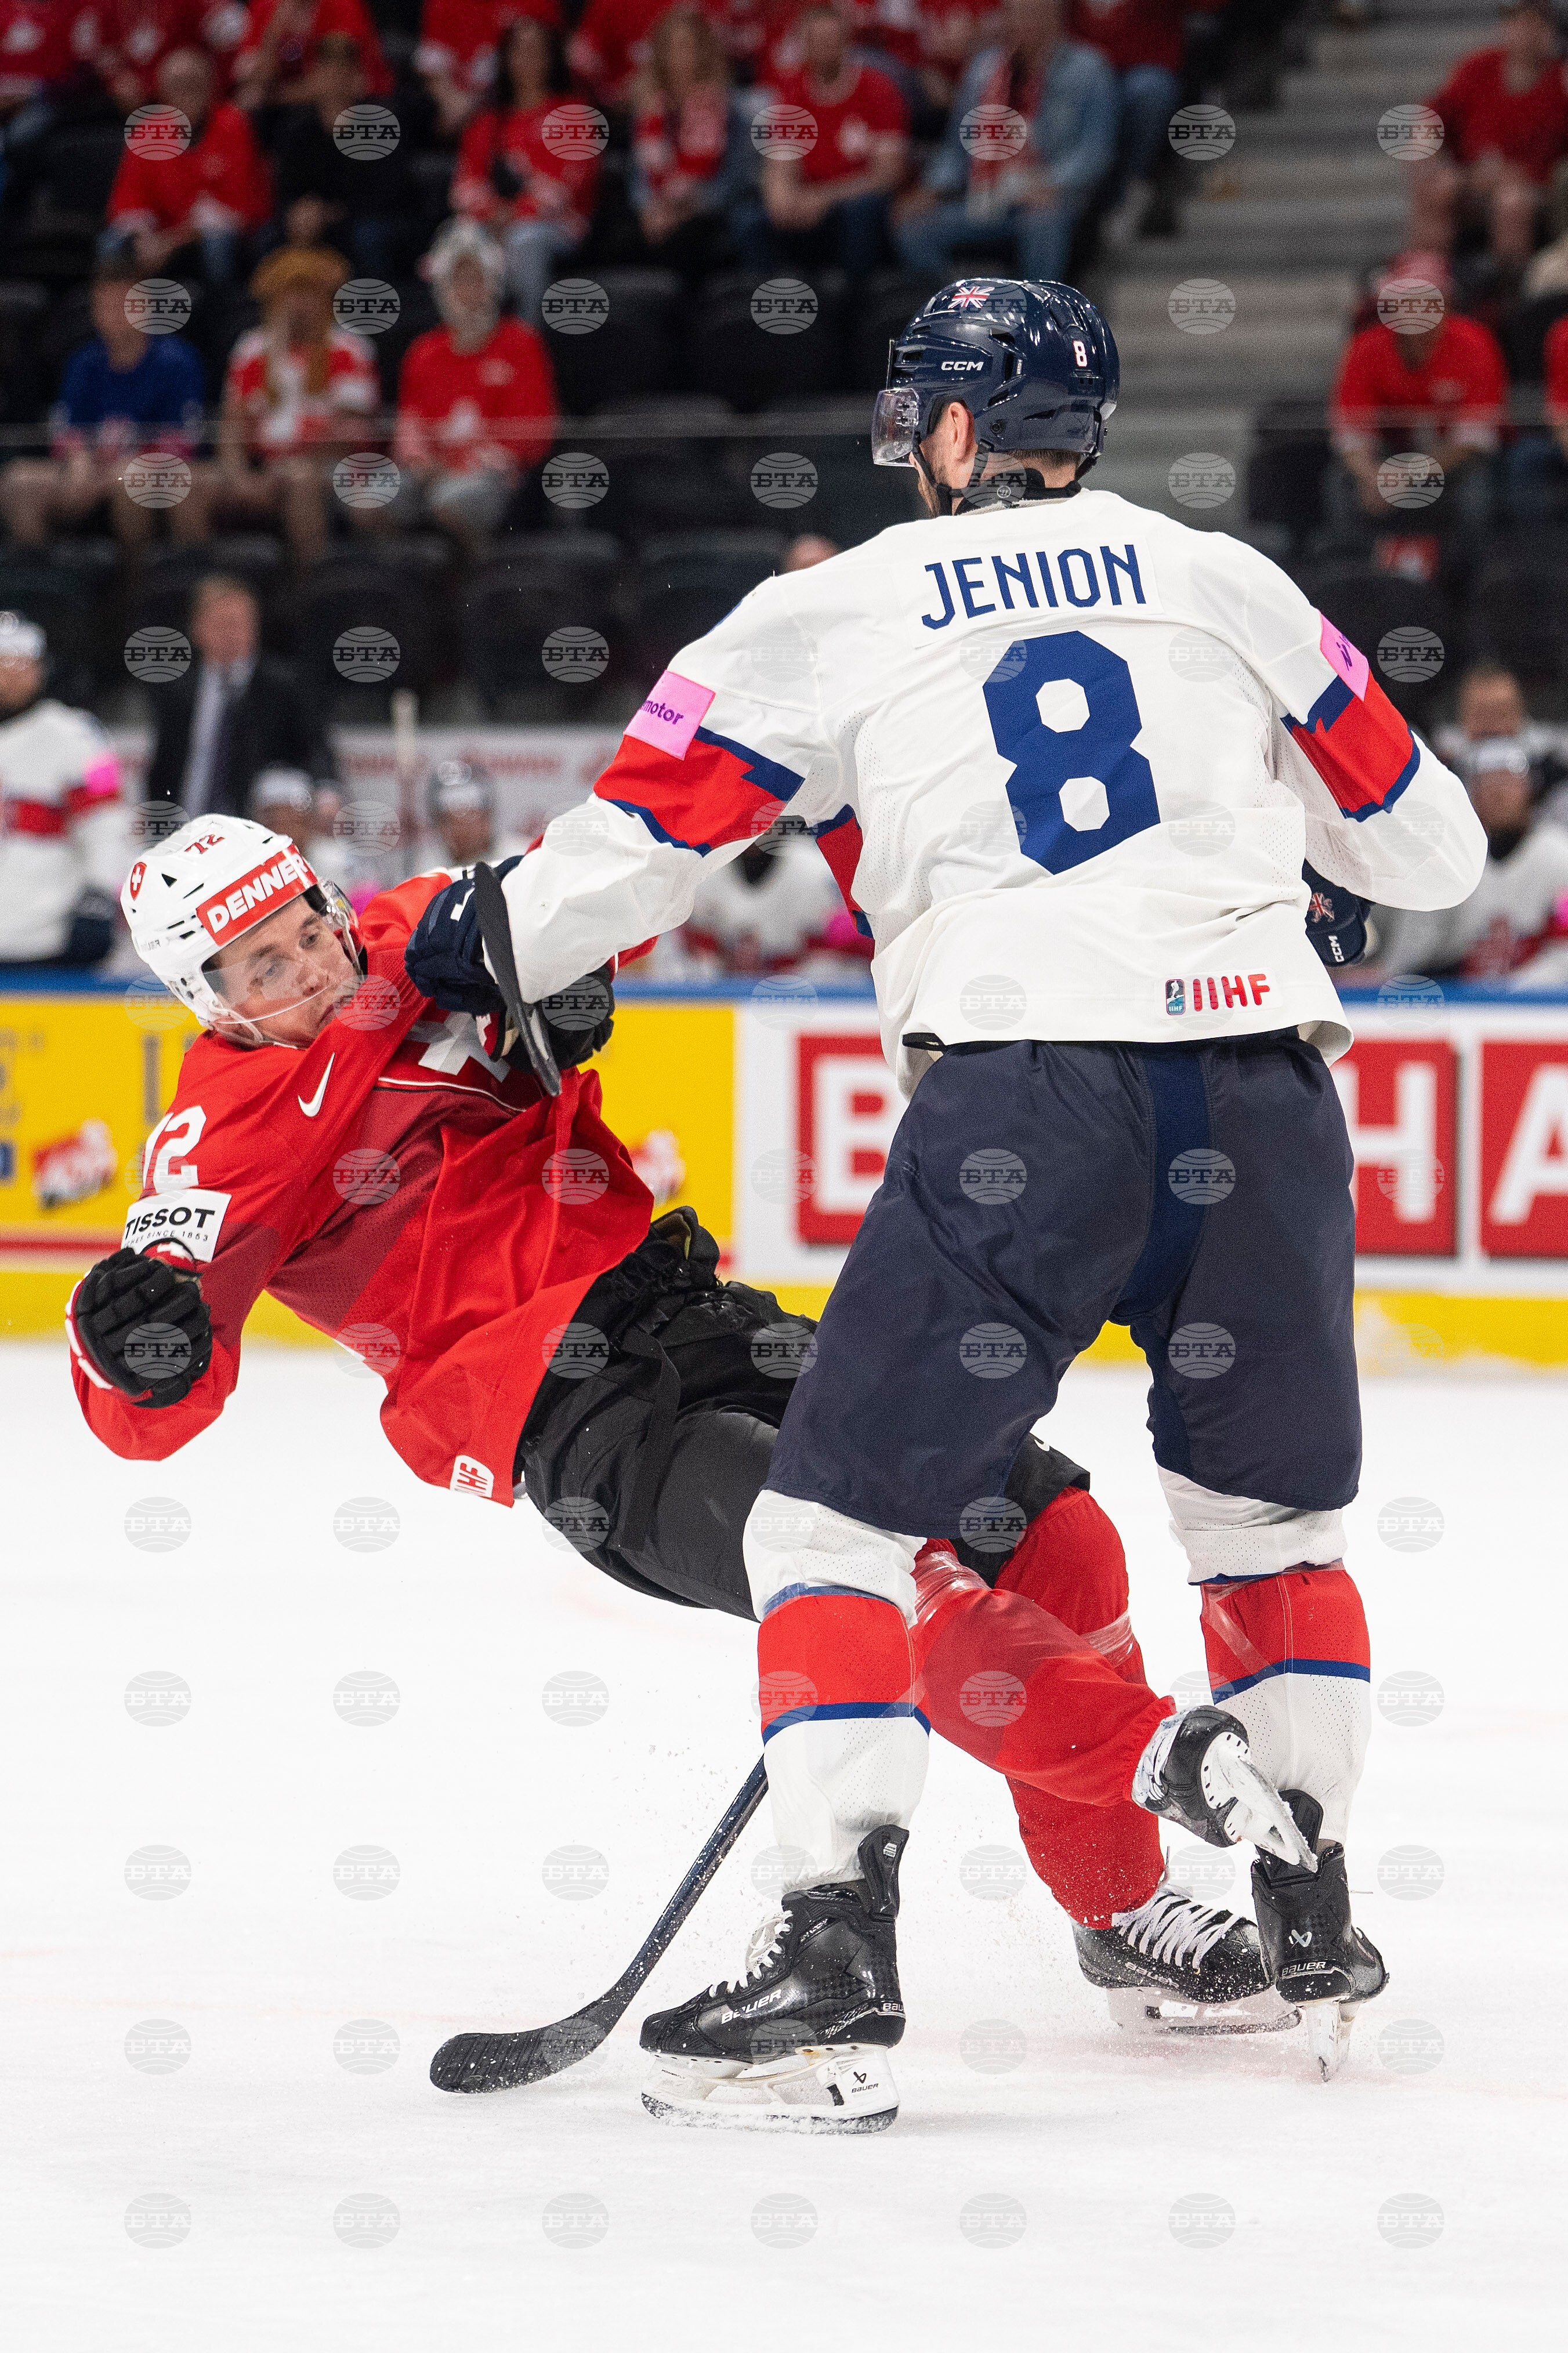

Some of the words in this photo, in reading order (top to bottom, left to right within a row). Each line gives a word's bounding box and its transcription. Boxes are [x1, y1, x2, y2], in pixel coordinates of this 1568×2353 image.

[941, 361, 984, 371] CCM
[1073, 340, 1087, 367] 8
[921, 544, 1146, 630] JENION
[982, 630, 1161, 875] 8
[184, 834, 225, 855] 72
[207, 853, 308, 934] DENNER
[1328, 935, 1345, 962] CCM
[1193, 973, 1270, 1012] IIHF
[125, 1207, 216, 1240] TISSOT
[1281, 1961, 1326, 1976] BAUER
[882, 2003, 904, 2011] BAU
[851, 2083, 879, 2093] BAUER
